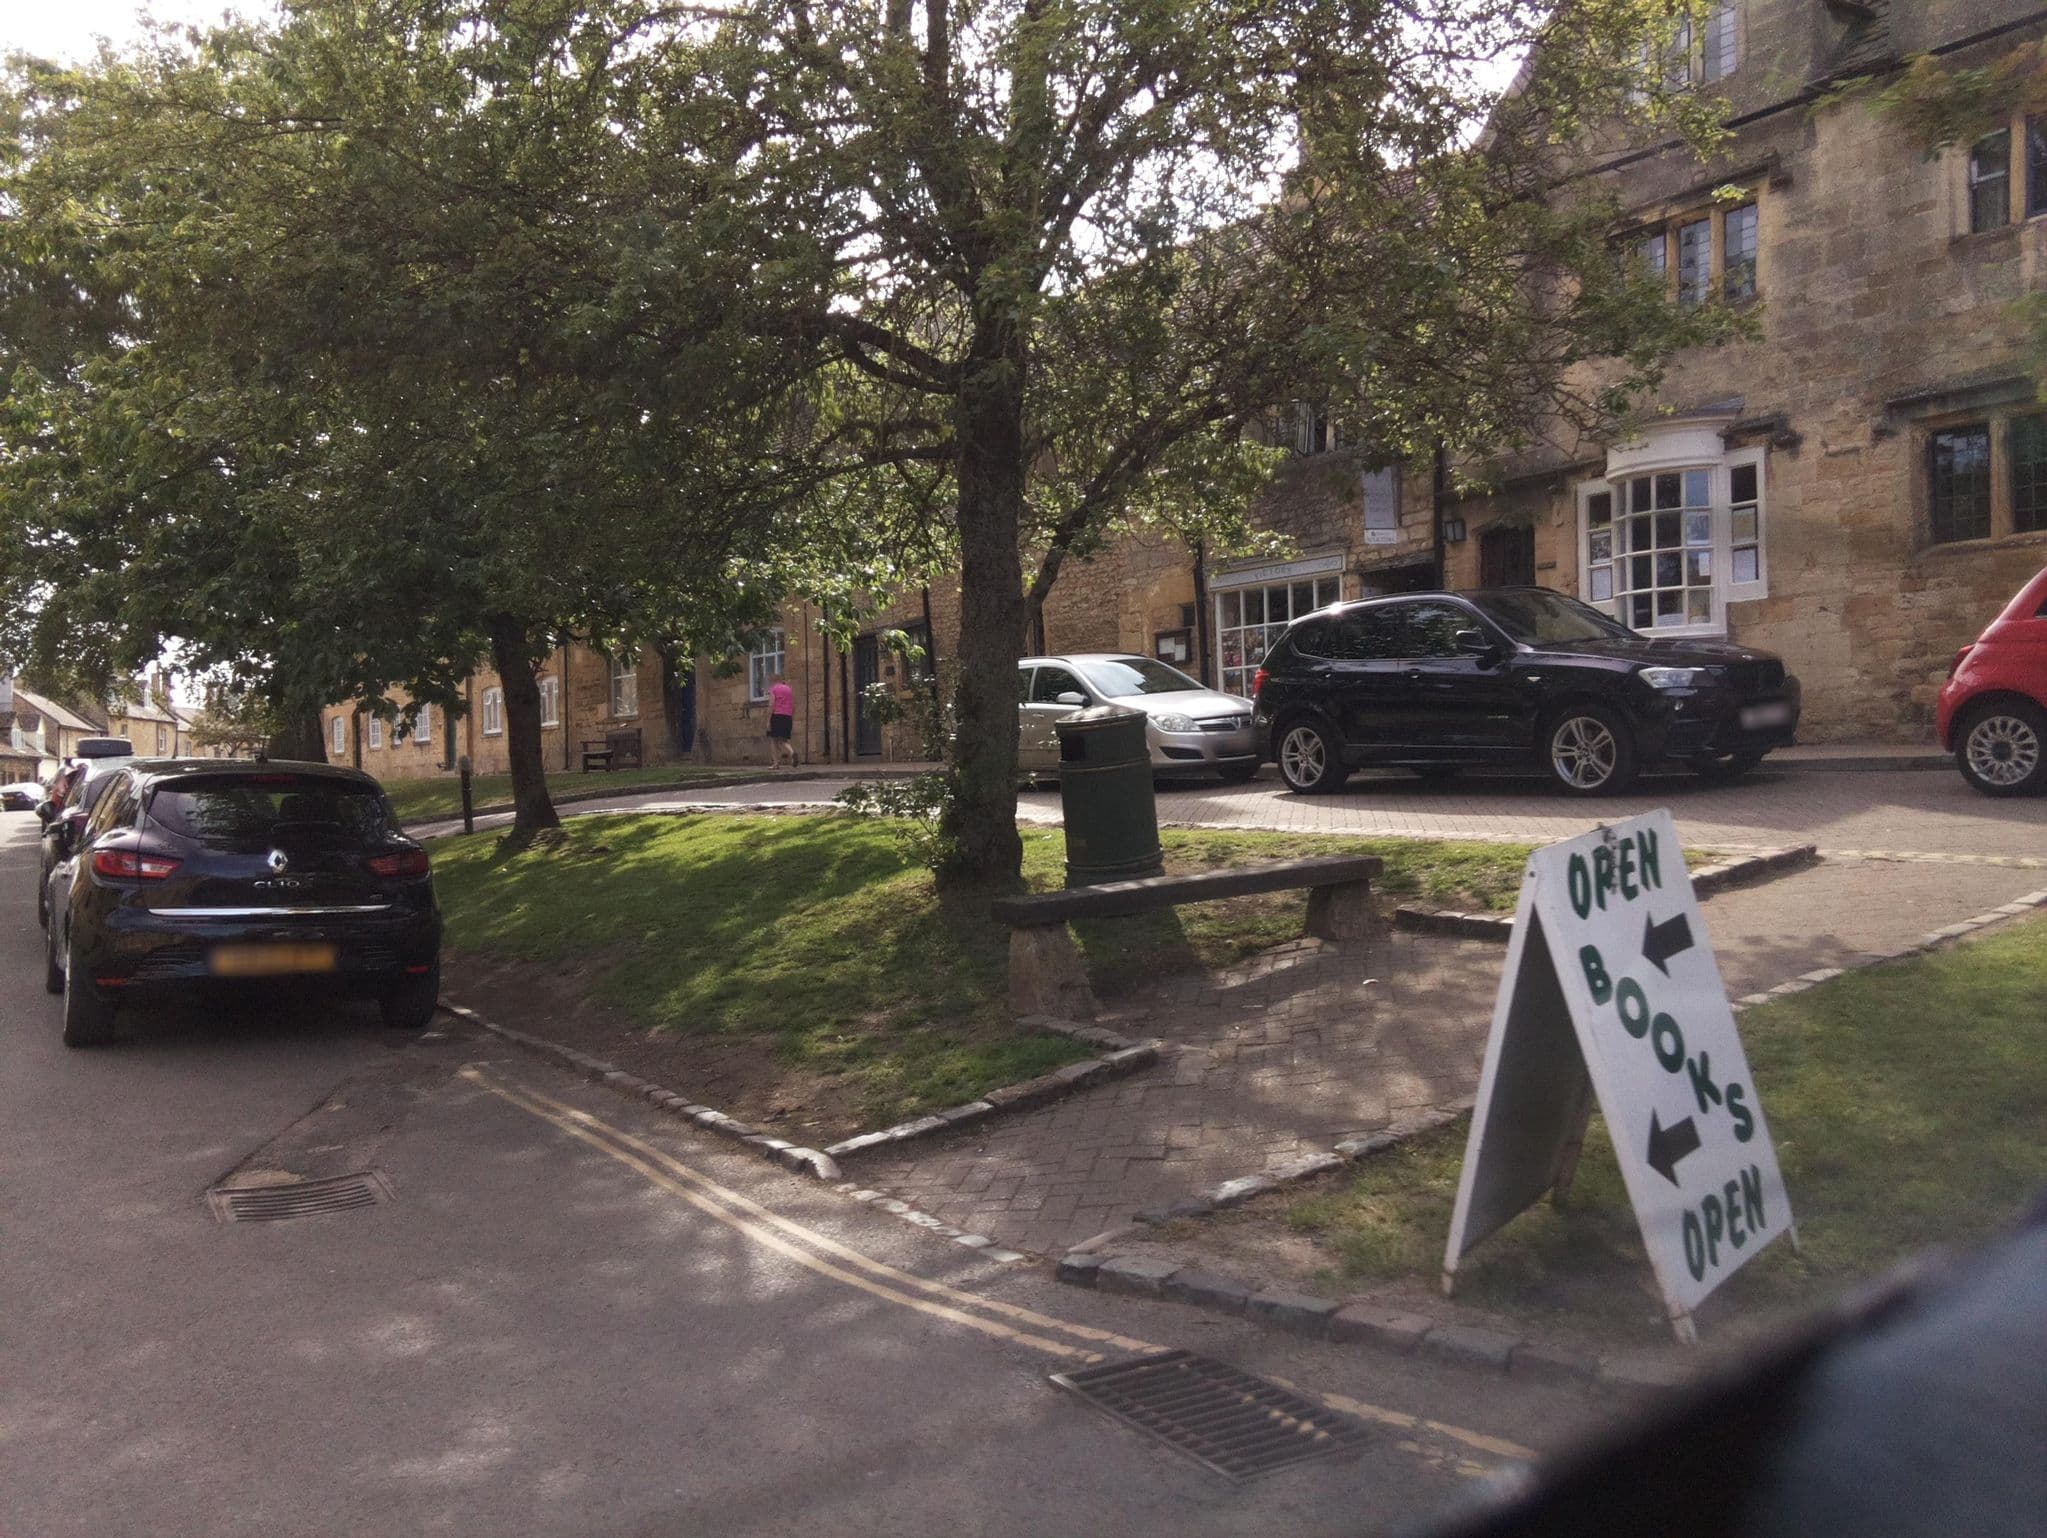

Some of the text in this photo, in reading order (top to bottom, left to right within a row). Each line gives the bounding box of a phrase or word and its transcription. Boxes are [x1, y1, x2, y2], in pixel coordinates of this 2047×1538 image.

[1568, 828, 1662, 920] OPEN
[1579, 944, 1754, 1143] BOOKS
[1682, 1164, 1766, 1282] OPEN
